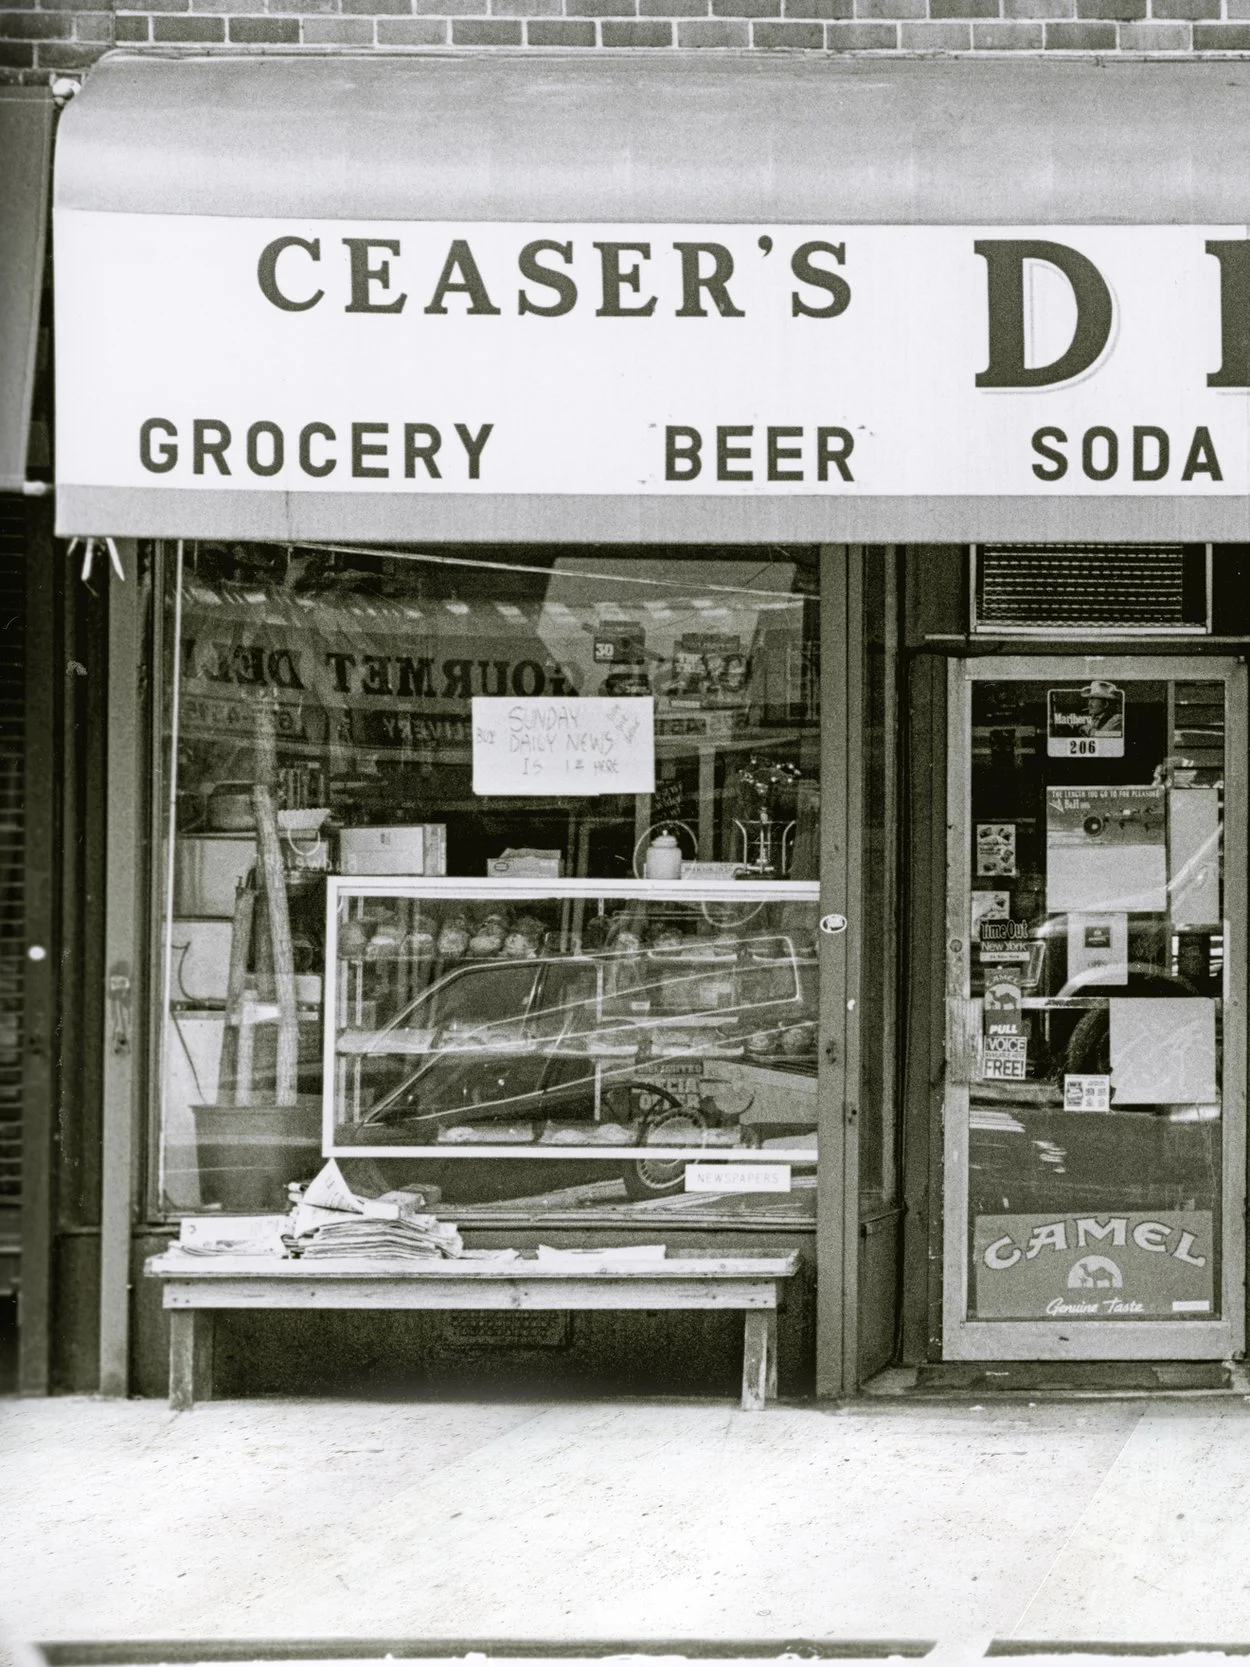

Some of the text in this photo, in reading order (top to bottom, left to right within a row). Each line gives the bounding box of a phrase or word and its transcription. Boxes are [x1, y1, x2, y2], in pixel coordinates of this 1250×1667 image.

[258, 236, 850, 318] CEASER'S
[141, 419, 492, 479] GROCERY
[666, 426, 854, 481] BEER
[1032, 426, 1222, 481] SODA
[507, 704, 581, 733] SUNDAY
[1053, 712, 1092, 726] Marlboro
[509, 731, 614, 756] DAILY NEWS
[1069, 740, 1096, 755] 206
[982, 920, 1029, 939] Time Out
[982, 940, 1029, 951] New York
[989, 1024, 1019, 1034] PULL
[988, 1038, 1026, 1052] VOICE
[985, 1060, 1024, 1077] FREE!
[696, 1170, 780, 1186] NEWSPAPERS
[983, 1215, 1207, 1270] CAMEL
[1046, 1297, 1145, 1316] Genuine Taste
